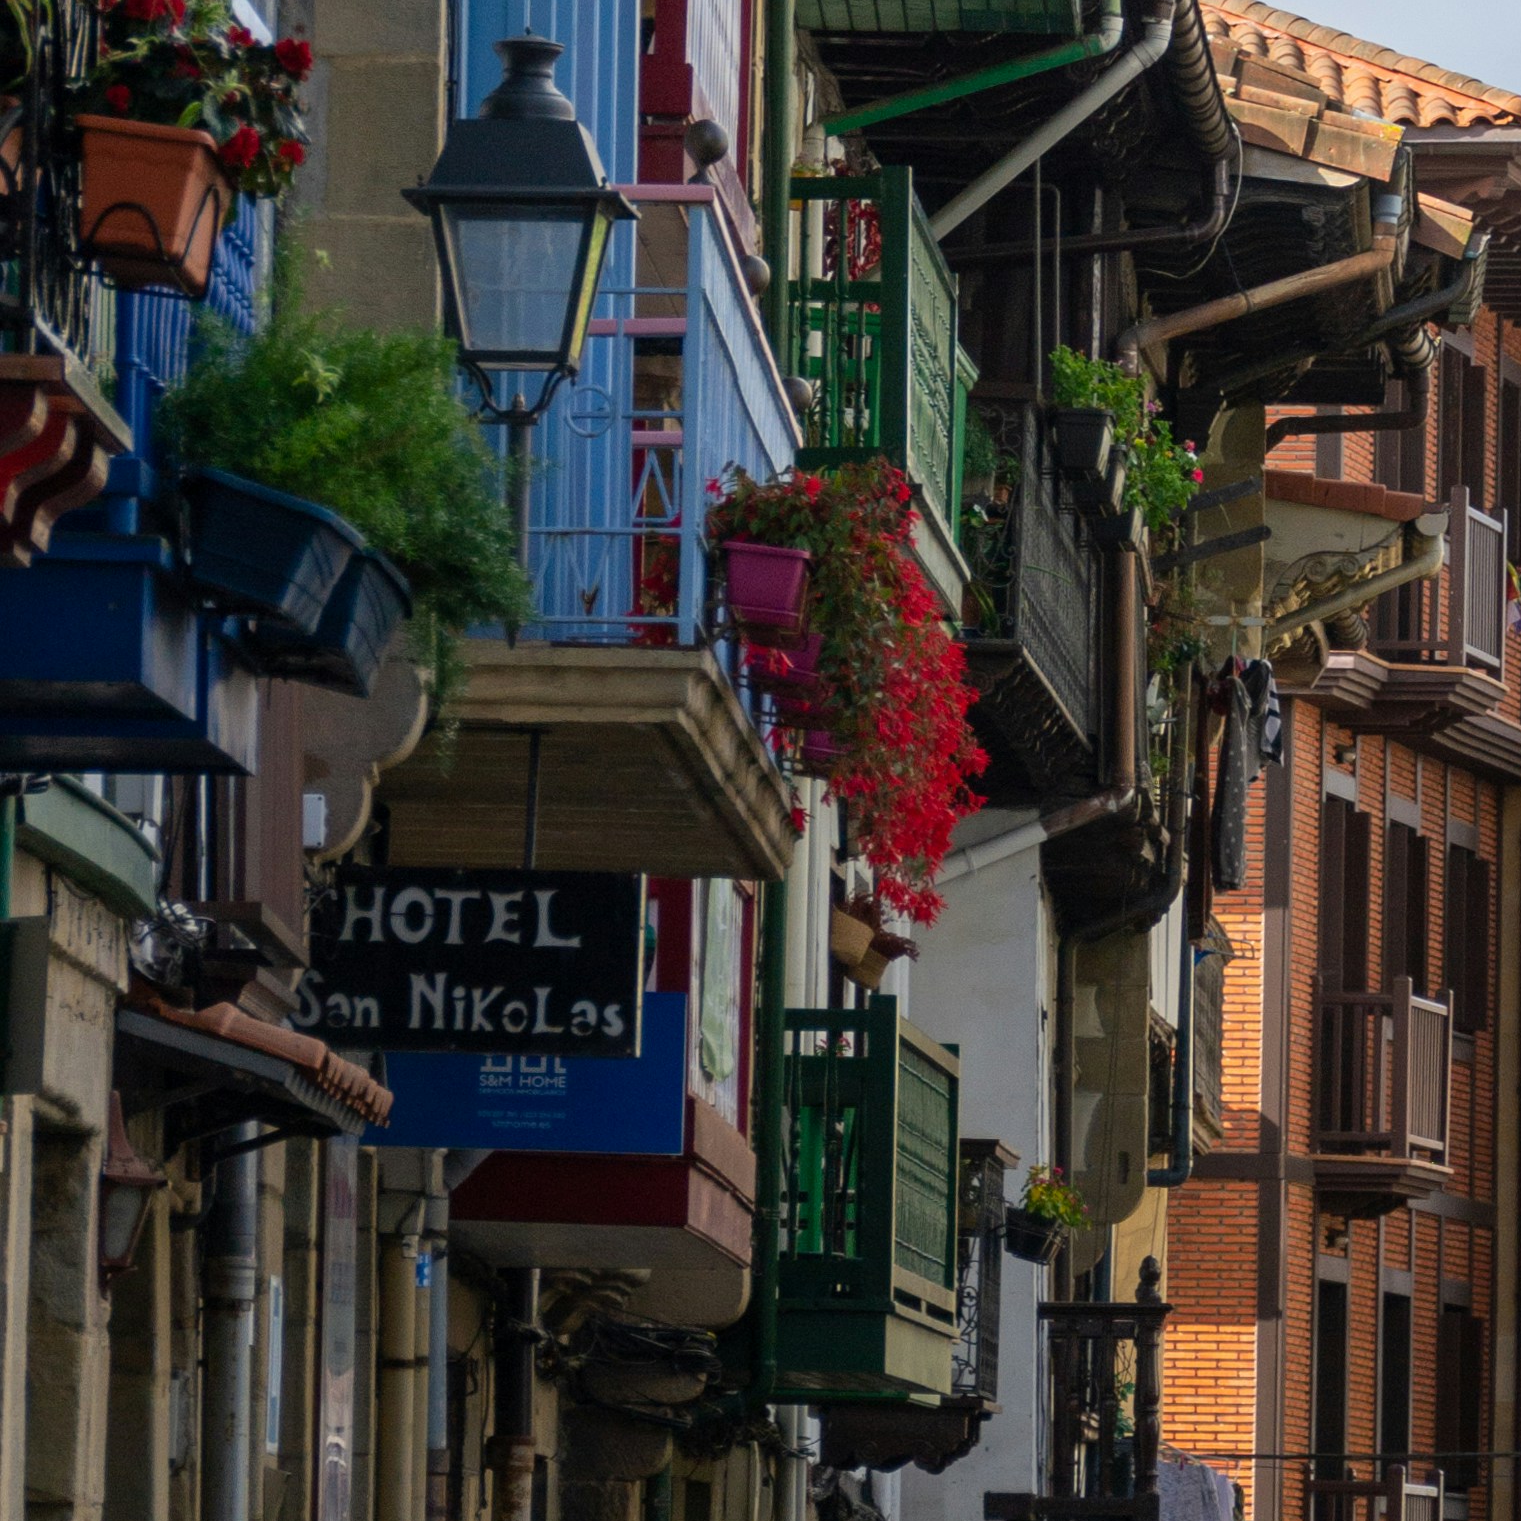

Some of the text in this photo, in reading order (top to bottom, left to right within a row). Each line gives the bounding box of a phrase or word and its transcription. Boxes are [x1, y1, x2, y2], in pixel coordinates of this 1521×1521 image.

[338, 886, 581, 948] HOTEL
[291, 968, 380, 1028] San
[479, 1074, 566, 1088] S&M HOME
